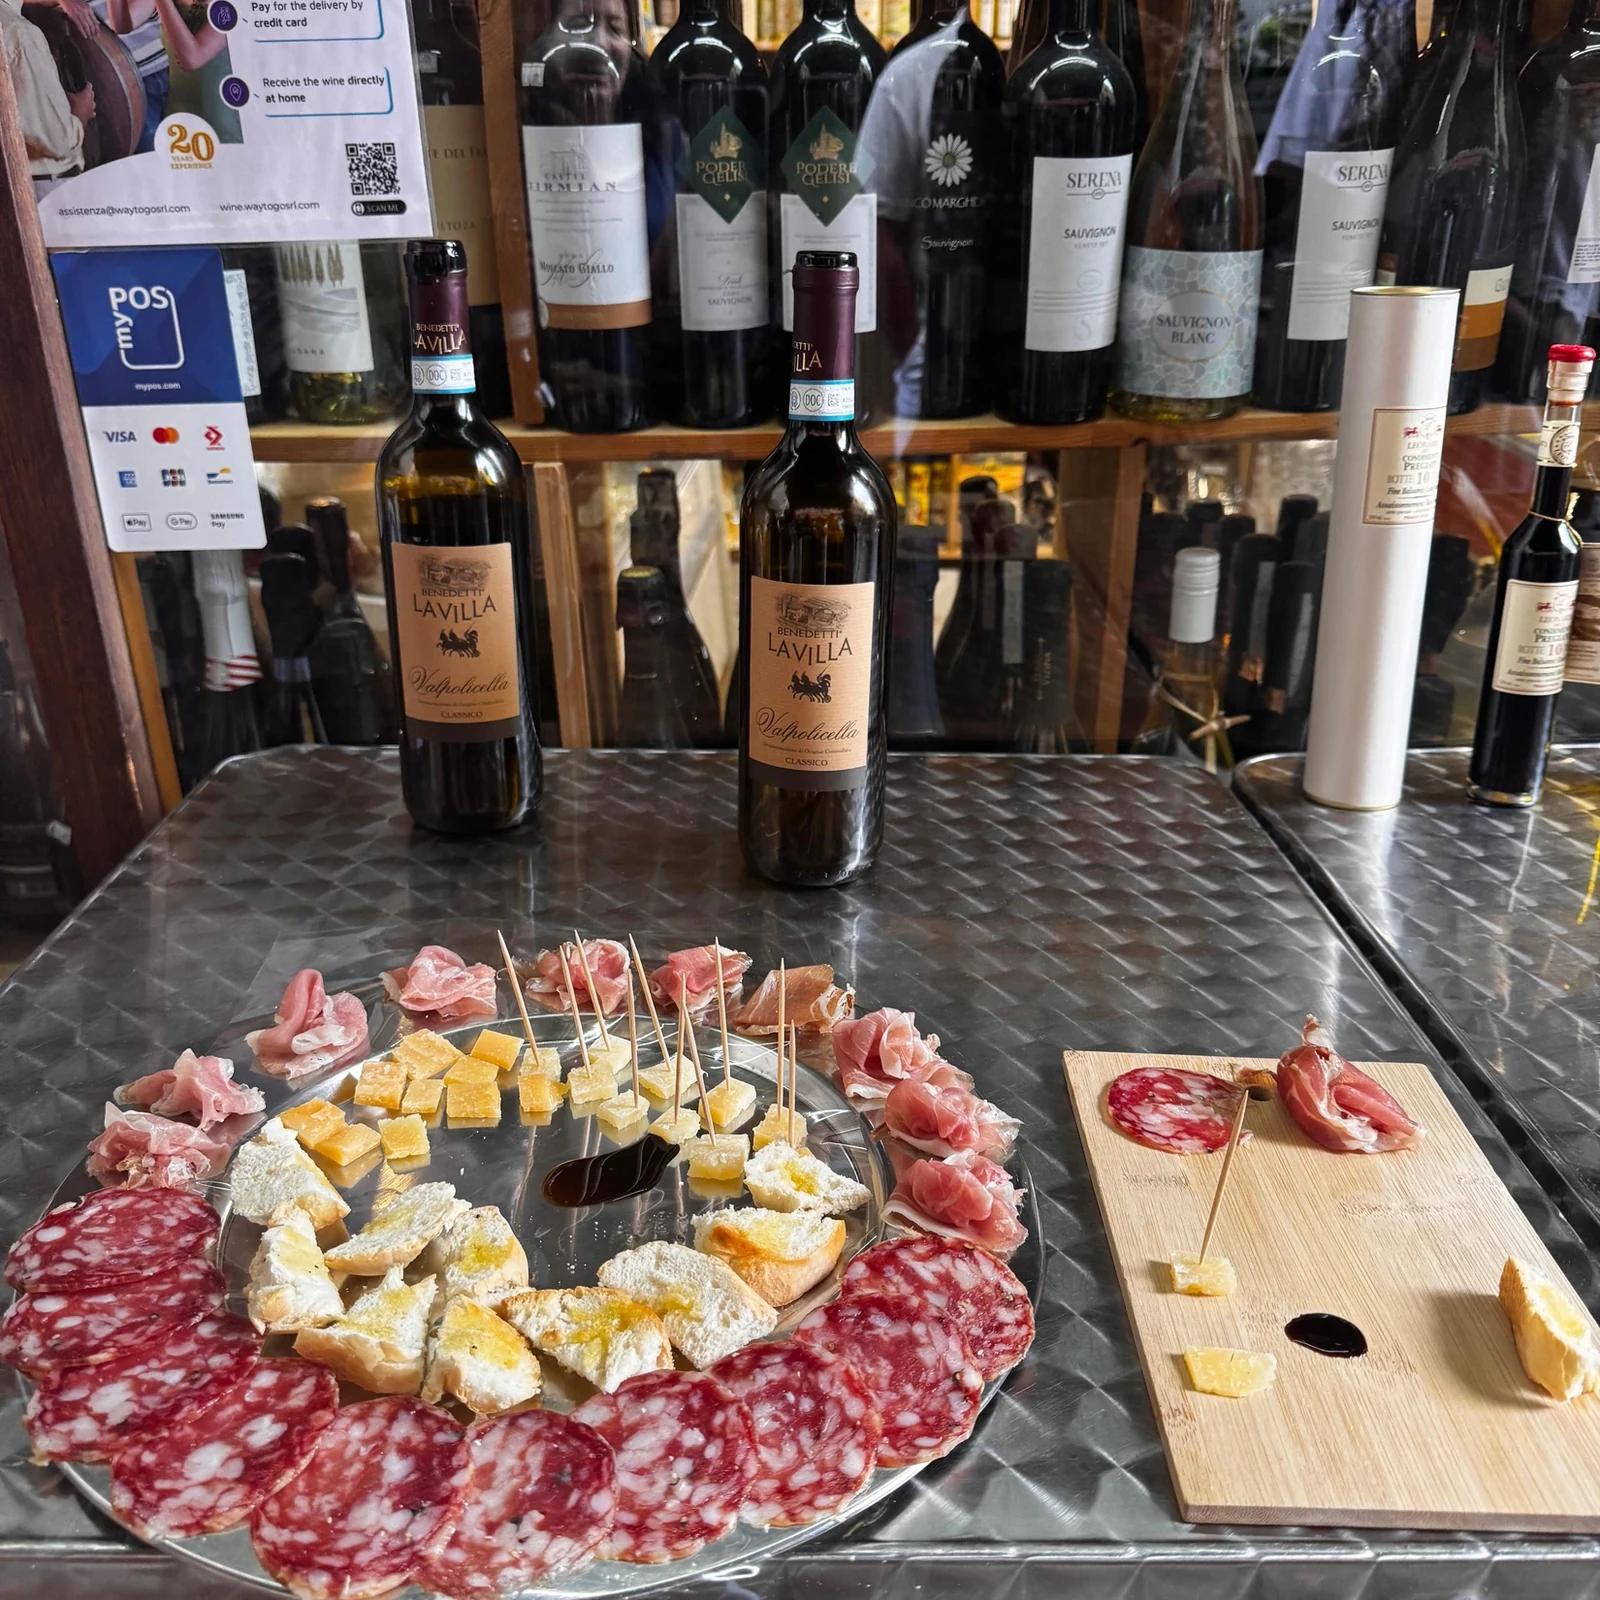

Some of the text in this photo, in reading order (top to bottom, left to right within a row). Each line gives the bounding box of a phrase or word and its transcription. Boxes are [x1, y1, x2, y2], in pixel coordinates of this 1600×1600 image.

[251, 0, 364, 13] Pay for the delivery by
[253, 17, 308, 28] credit card
[262, 75, 385, 88] Receive the wine directly
[265, 94, 306, 103] at home
[167, 124, 215, 162] 20
[171, 155, 194, 163] YEARS
[696, 160, 748, 174] PODER
[796, 161, 857, 175] PODERE
[1066, 170, 1122, 189] SERENA
[58, 204, 191, 217] assistenza@waytogosrl.com
[219, 201, 320, 214] wine.waytogosrl.com
[366, 205, 386, 213] SCAN
[1063, 227, 1116, 239] SAUVIGNON
[920, 235, 973, 251] Sauvignon
[578, 262, 615, 275] GIALLO
[416, 323, 459, 332] BENEDETTI
[1155, 315, 1231, 330] SAUVIGNON
[1171, 331, 1216, 344] BLANC
[428, 368, 445, 380] DOC
[135, 382, 181, 391] mypos.com
[805, 394, 822, 406] DOC
[104, 431, 137, 443] VISA
[421, 588, 481, 597] BENEDETTI
[412, 593, 497, 623] LAVILLA
[777, 627, 839, 639] BENEDETTI
[768, 632, 853, 666] LAVILLA
[408, 665, 510, 699] Valpolicella
[756, 706, 860, 743] Valpolicella
[785, 757, 828, 766] CLASSICO
